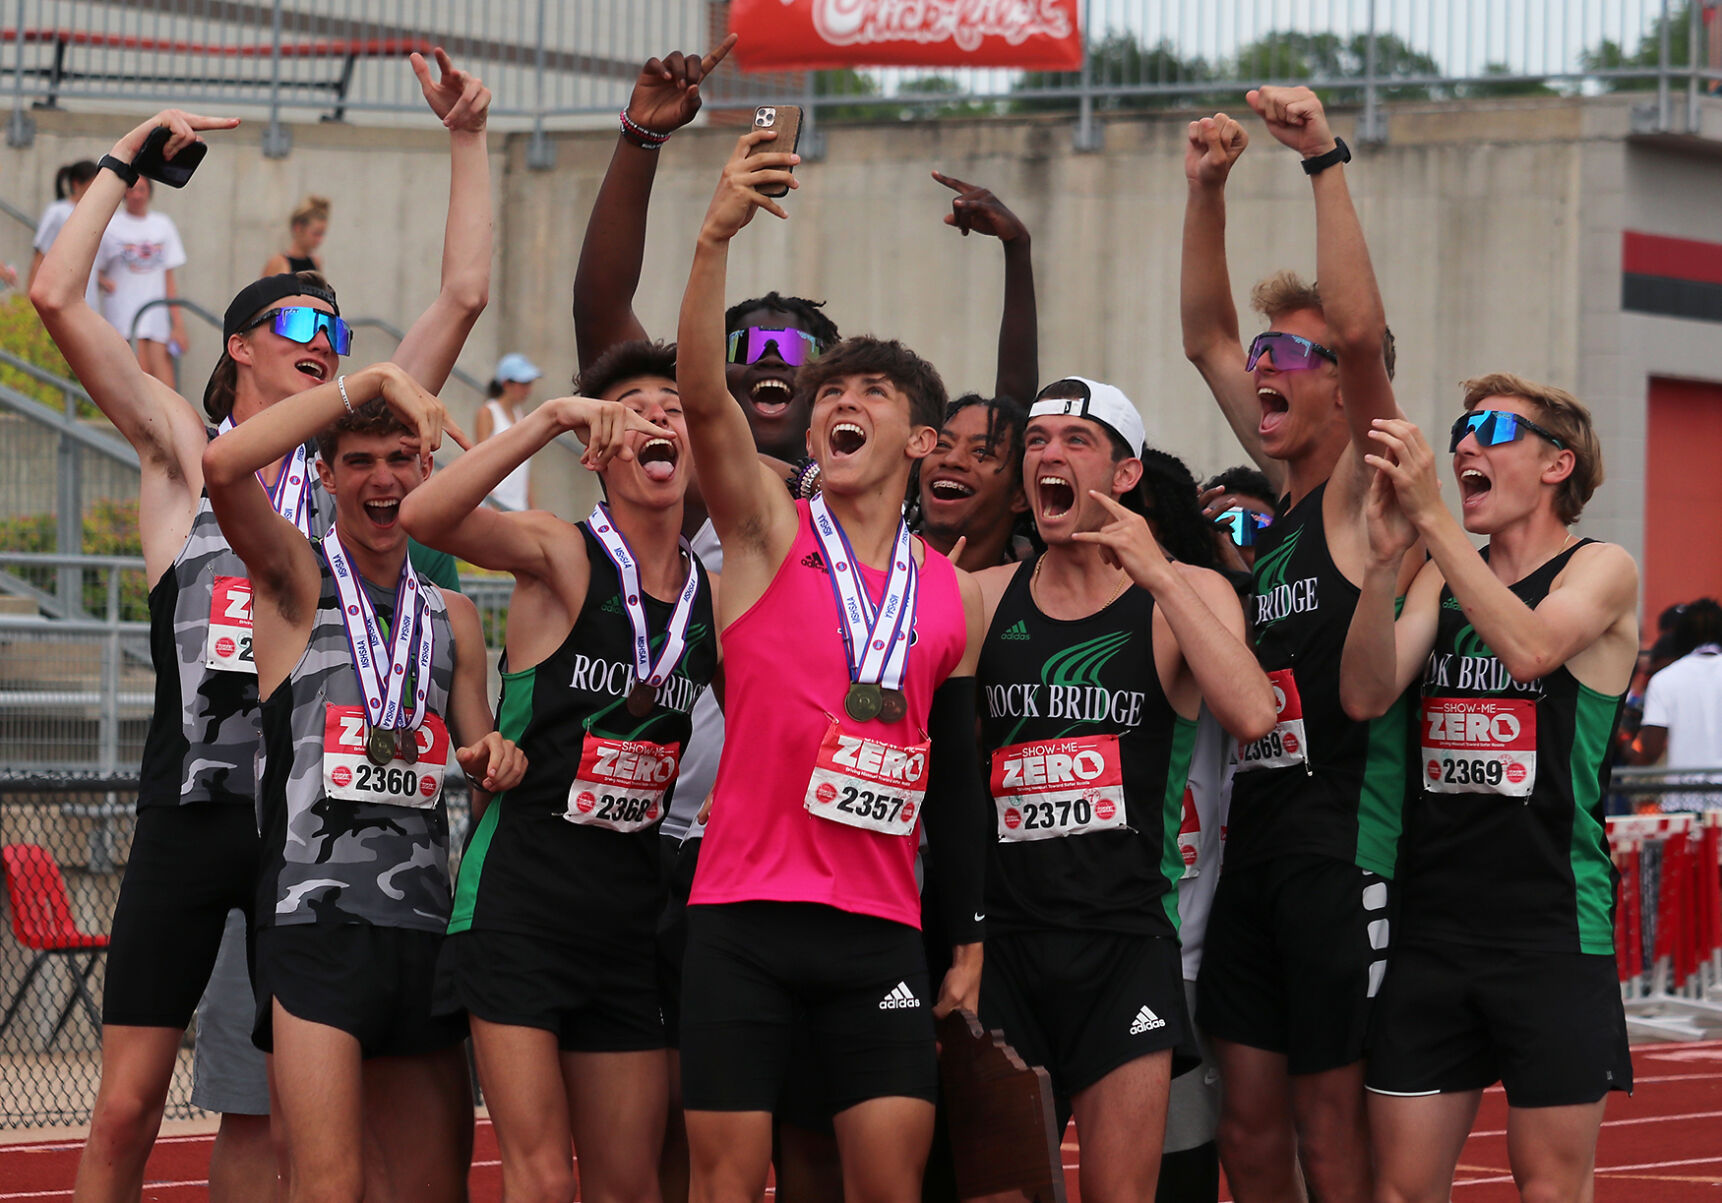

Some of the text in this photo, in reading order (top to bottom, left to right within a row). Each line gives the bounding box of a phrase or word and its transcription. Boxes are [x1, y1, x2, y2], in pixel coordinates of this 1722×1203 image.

[637, 636, 647, 665] MSHSAA
[1000, 632, 1031, 641] adidas
[357, 639, 370, 668] MSHSAA
[985, 683, 1145, 727] ROCK BRIDGE
[1443, 703, 1497, 714] SHOW-ME
[1427, 711, 1520, 743] ZERO
[831, 734, 925, 782] ZERO
[1022, 742, 1078, 757] SHOW-ME
[592, 746, 675, 783] ZERO
[1002, 750, 1105, 788] ZERO
[1443, 758, 1503, 786] 2369
[355, 764, 417, 797] 2360
[596, 794, 651, 822] 2368
[837, 786, 904, 823] 2357
[1023, 798, 1092, 830] 2370
[879, 998, 920, 1009] adidas
[1129, 1017, 1166, 1035] adidas
